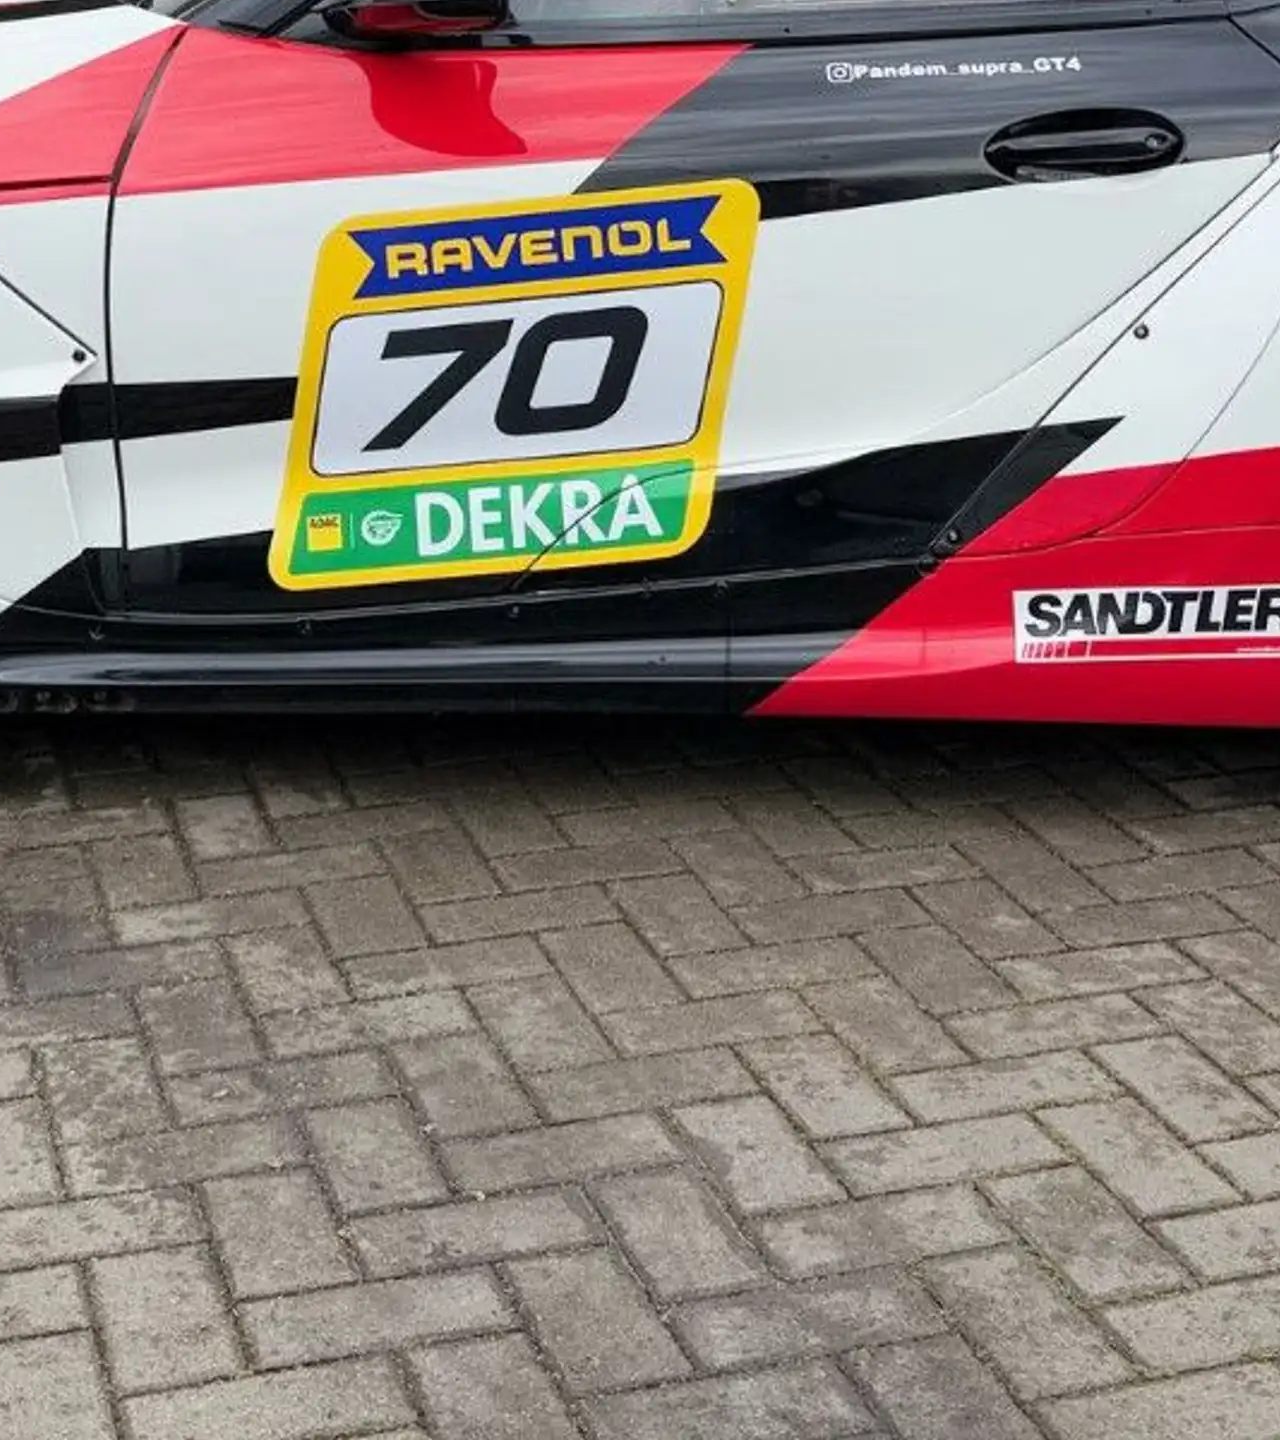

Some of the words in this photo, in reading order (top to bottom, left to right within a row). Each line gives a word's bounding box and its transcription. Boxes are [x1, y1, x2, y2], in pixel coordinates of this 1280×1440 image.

[384, 218, 691, 279] RAVENOL
[360, 305, 649, 452] 70
[414, 474, 665, 557] DEKRA
